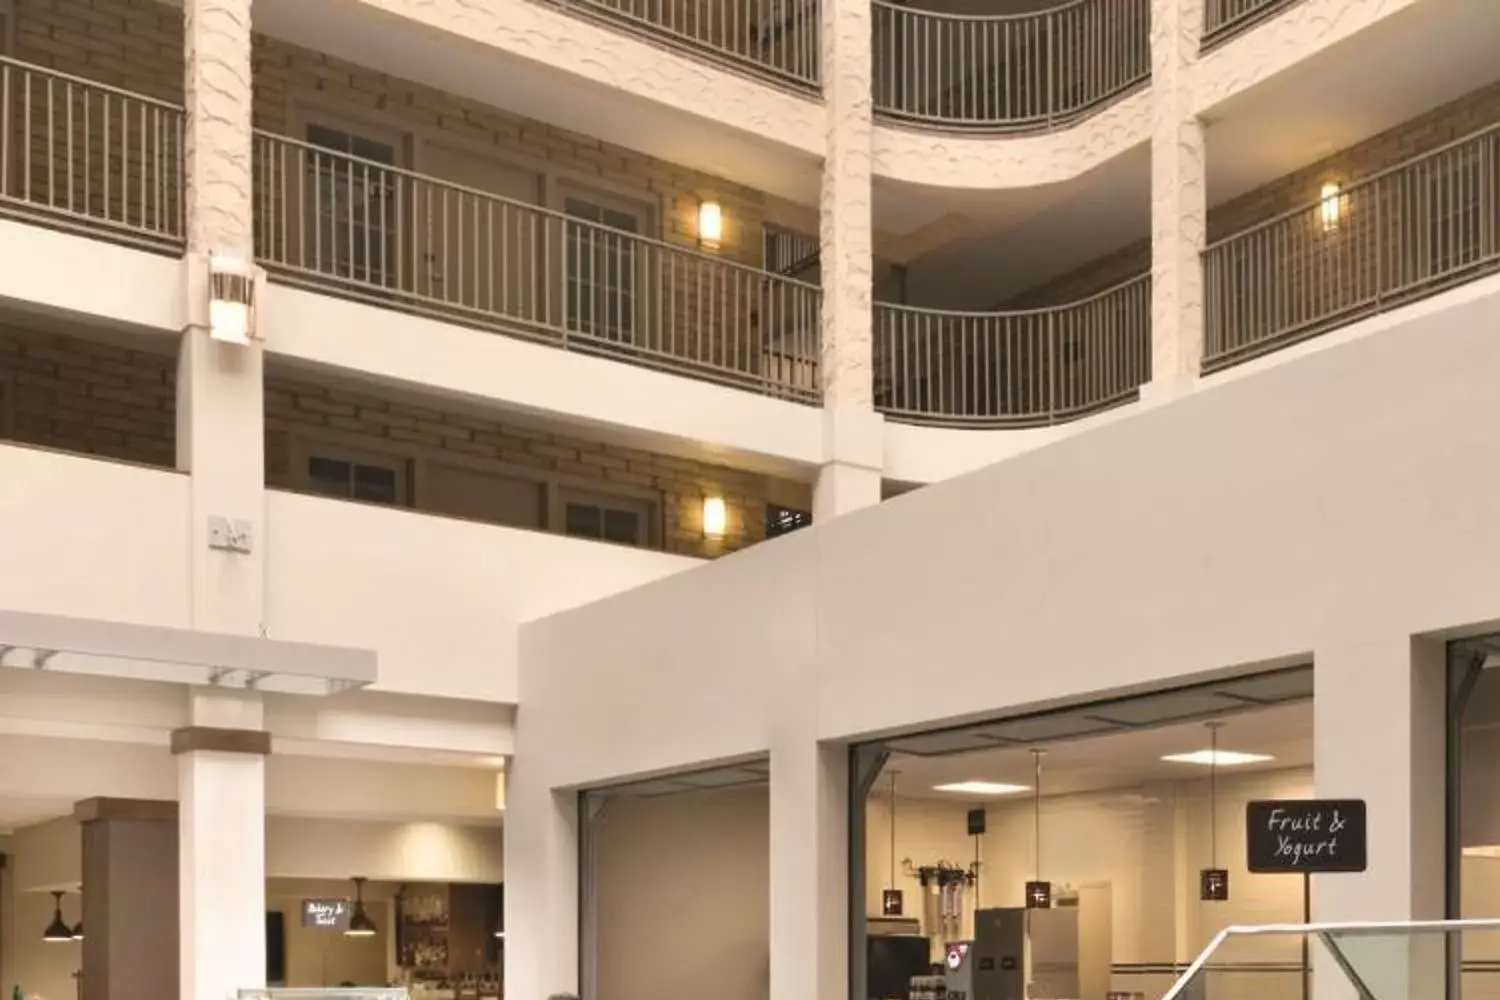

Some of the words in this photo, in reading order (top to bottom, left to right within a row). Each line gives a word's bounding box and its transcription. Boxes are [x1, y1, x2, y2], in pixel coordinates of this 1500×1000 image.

[1267, 808, 1321, 831] Fruit
[1329, 808, 1346, 833] &
[1273, 835, 1337, 865] Yogurt
